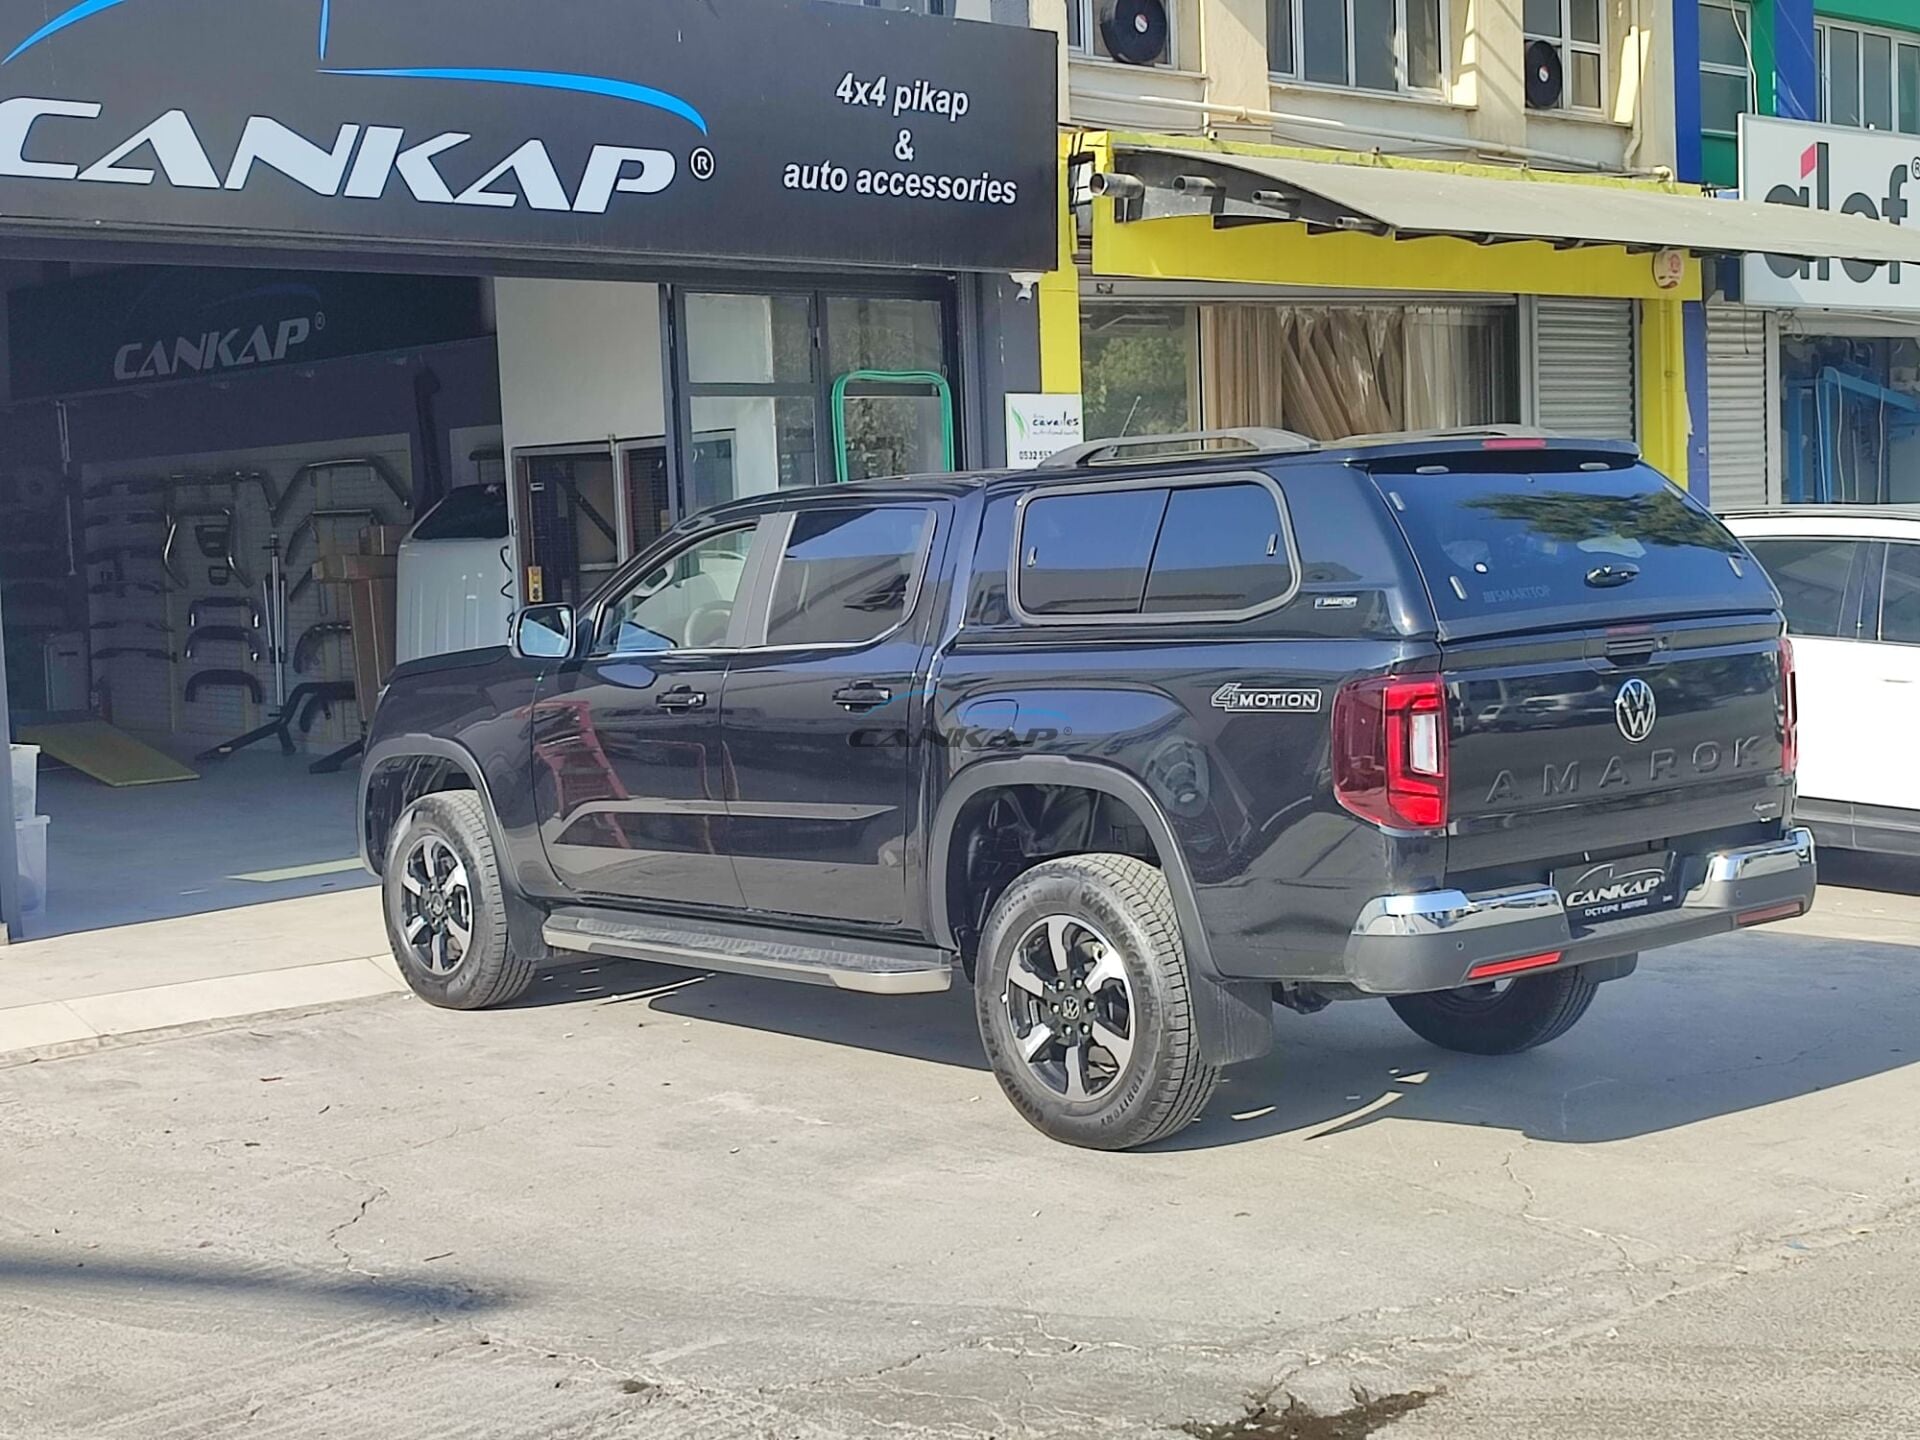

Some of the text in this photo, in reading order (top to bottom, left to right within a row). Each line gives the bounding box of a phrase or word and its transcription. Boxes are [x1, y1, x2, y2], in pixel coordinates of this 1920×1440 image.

[836, 72, 970, 122] 4x4 pikap
[0, 97, 677, 214] CANKAP
[894, 129, 914, 161] &
[783, 160, 1018, 205] auto accessories
[113, 317, 310, 381] CANKAP
[1211, 682, 1318, 710] 4MOTION
[1485, 735, 1761, 804] AMAROK
[1565, 876, 1660, 907] CANKAP
